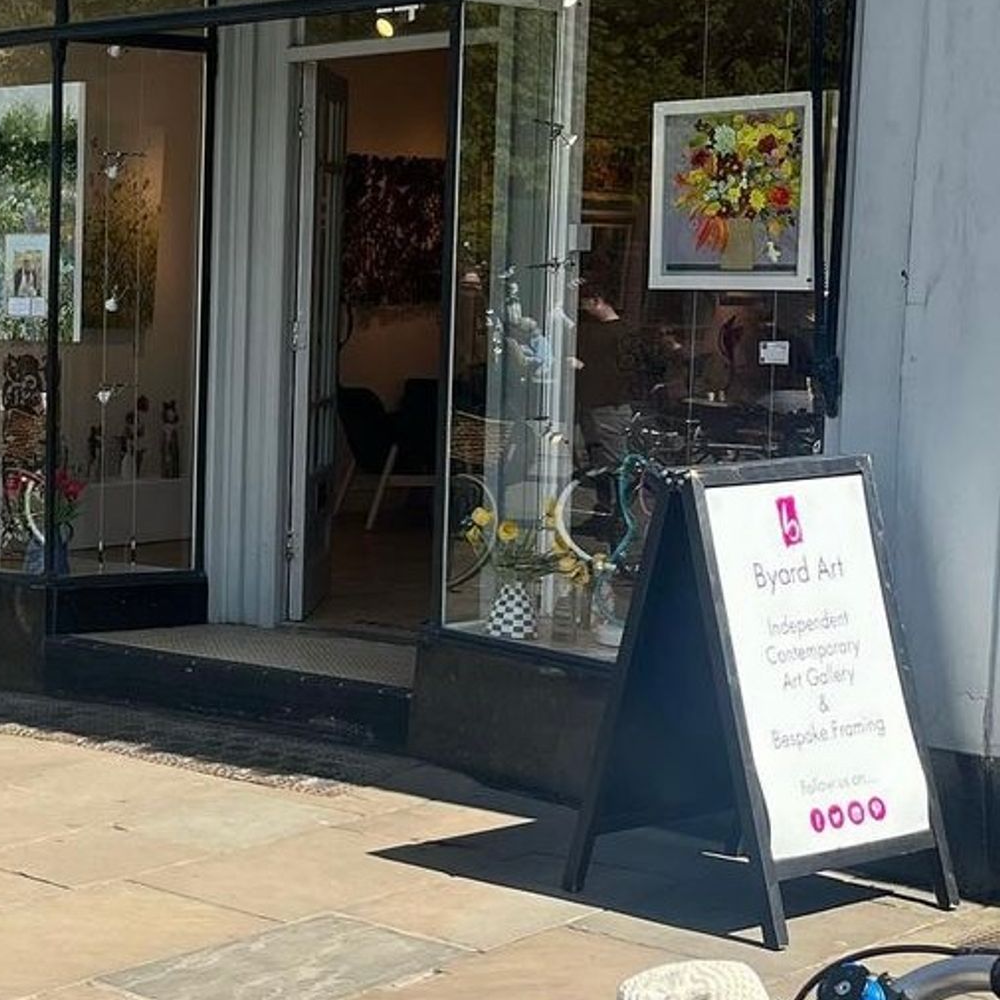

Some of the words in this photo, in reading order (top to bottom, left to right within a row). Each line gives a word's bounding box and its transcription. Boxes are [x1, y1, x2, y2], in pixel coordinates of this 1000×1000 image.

[752, 554, 811, 596] Byard
[817, 555, 844, 581] Art
[767, 609, 849, 639] Independent
[764, 639, 861, 665] Contemporary
[782, 670, 803, 691] Art
[805, 663, 855, 688] Gallery
[818, 692, 831, 714] &
[771, 724, 830, 751] Bespoke
[831, 717, 887, 740] Framing
